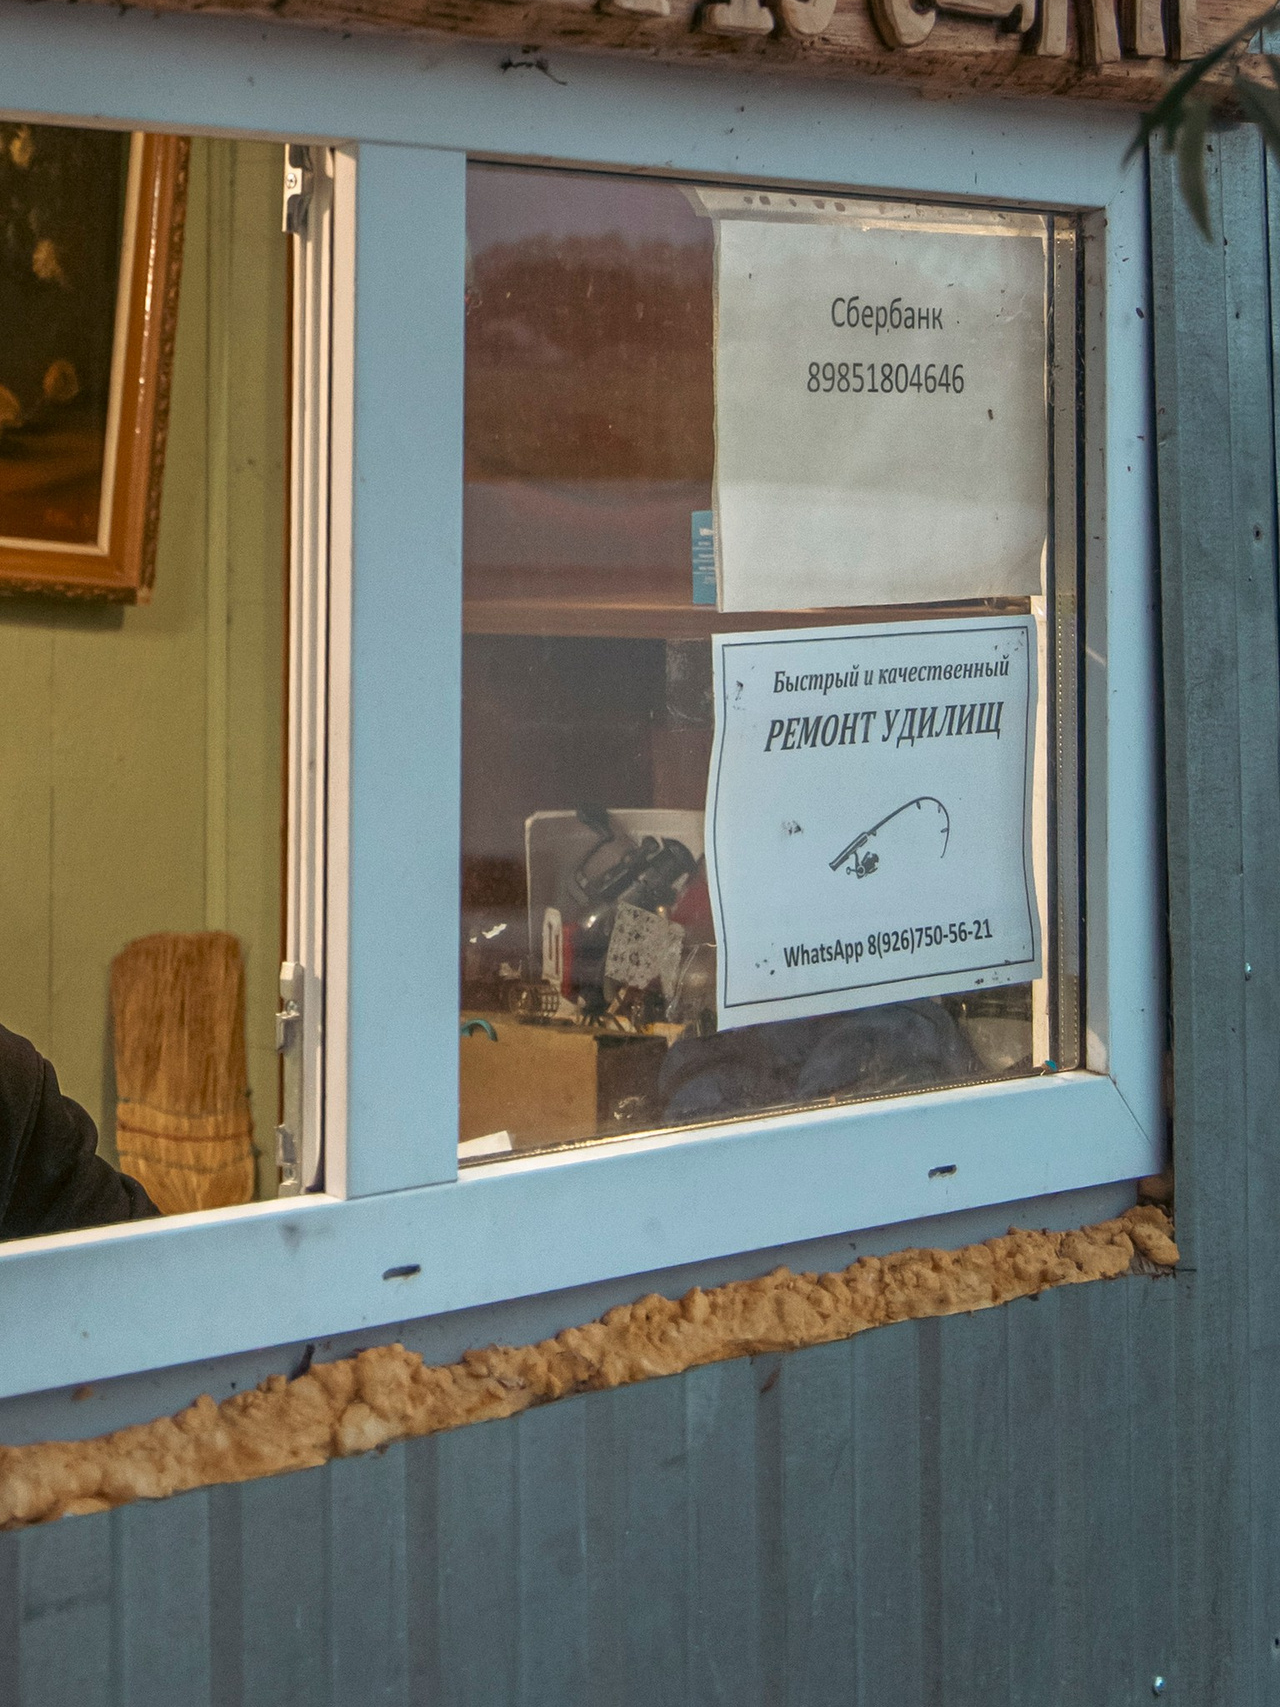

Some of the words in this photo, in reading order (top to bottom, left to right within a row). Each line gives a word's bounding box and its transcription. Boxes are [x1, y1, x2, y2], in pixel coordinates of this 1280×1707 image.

[831, 296, 943, 336] Сбербанк
[807, 362, 965, 393] 89851804646
[773, 664, 860, 695] Быстрый
[863, 670, 873, 685] и
[878, 654, 1010, 684] качественный
[764, 710, 877, 752] РЕМОНТ
[882, 701, 1004, 748] УДИЛИЩ
[784, 938, 864, 967] WhatsApp
[867, 918, 993, 959] 8(926)750-56-21
